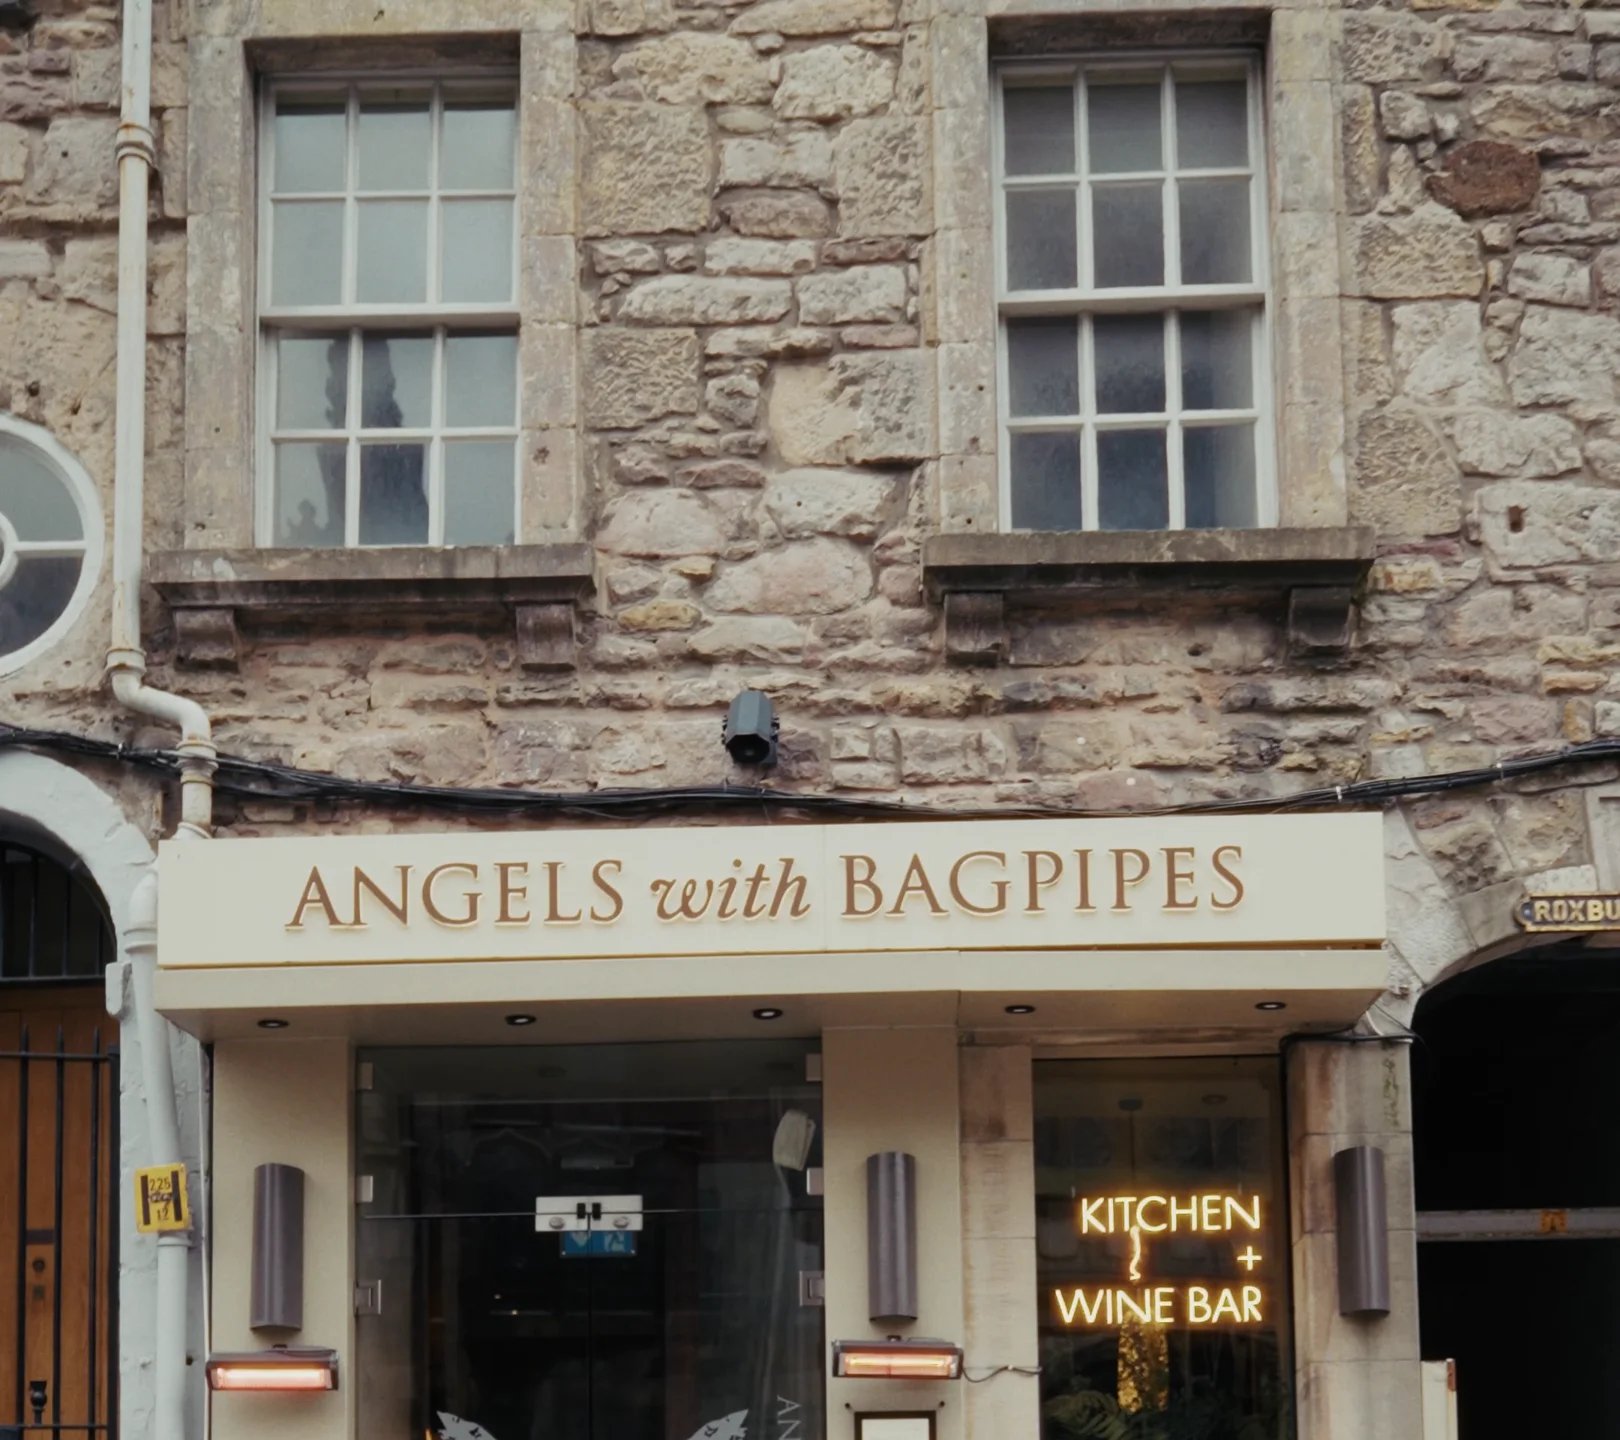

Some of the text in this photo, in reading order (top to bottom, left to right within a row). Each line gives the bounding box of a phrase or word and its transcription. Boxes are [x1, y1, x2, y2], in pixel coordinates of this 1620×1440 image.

[284, 844, 1245, 930] ANGELS with BAGPIPES
[1081, 1195, 1261, 1234] KITCHEN
[1055, 1286, 1262, 1325] WINE BAR
